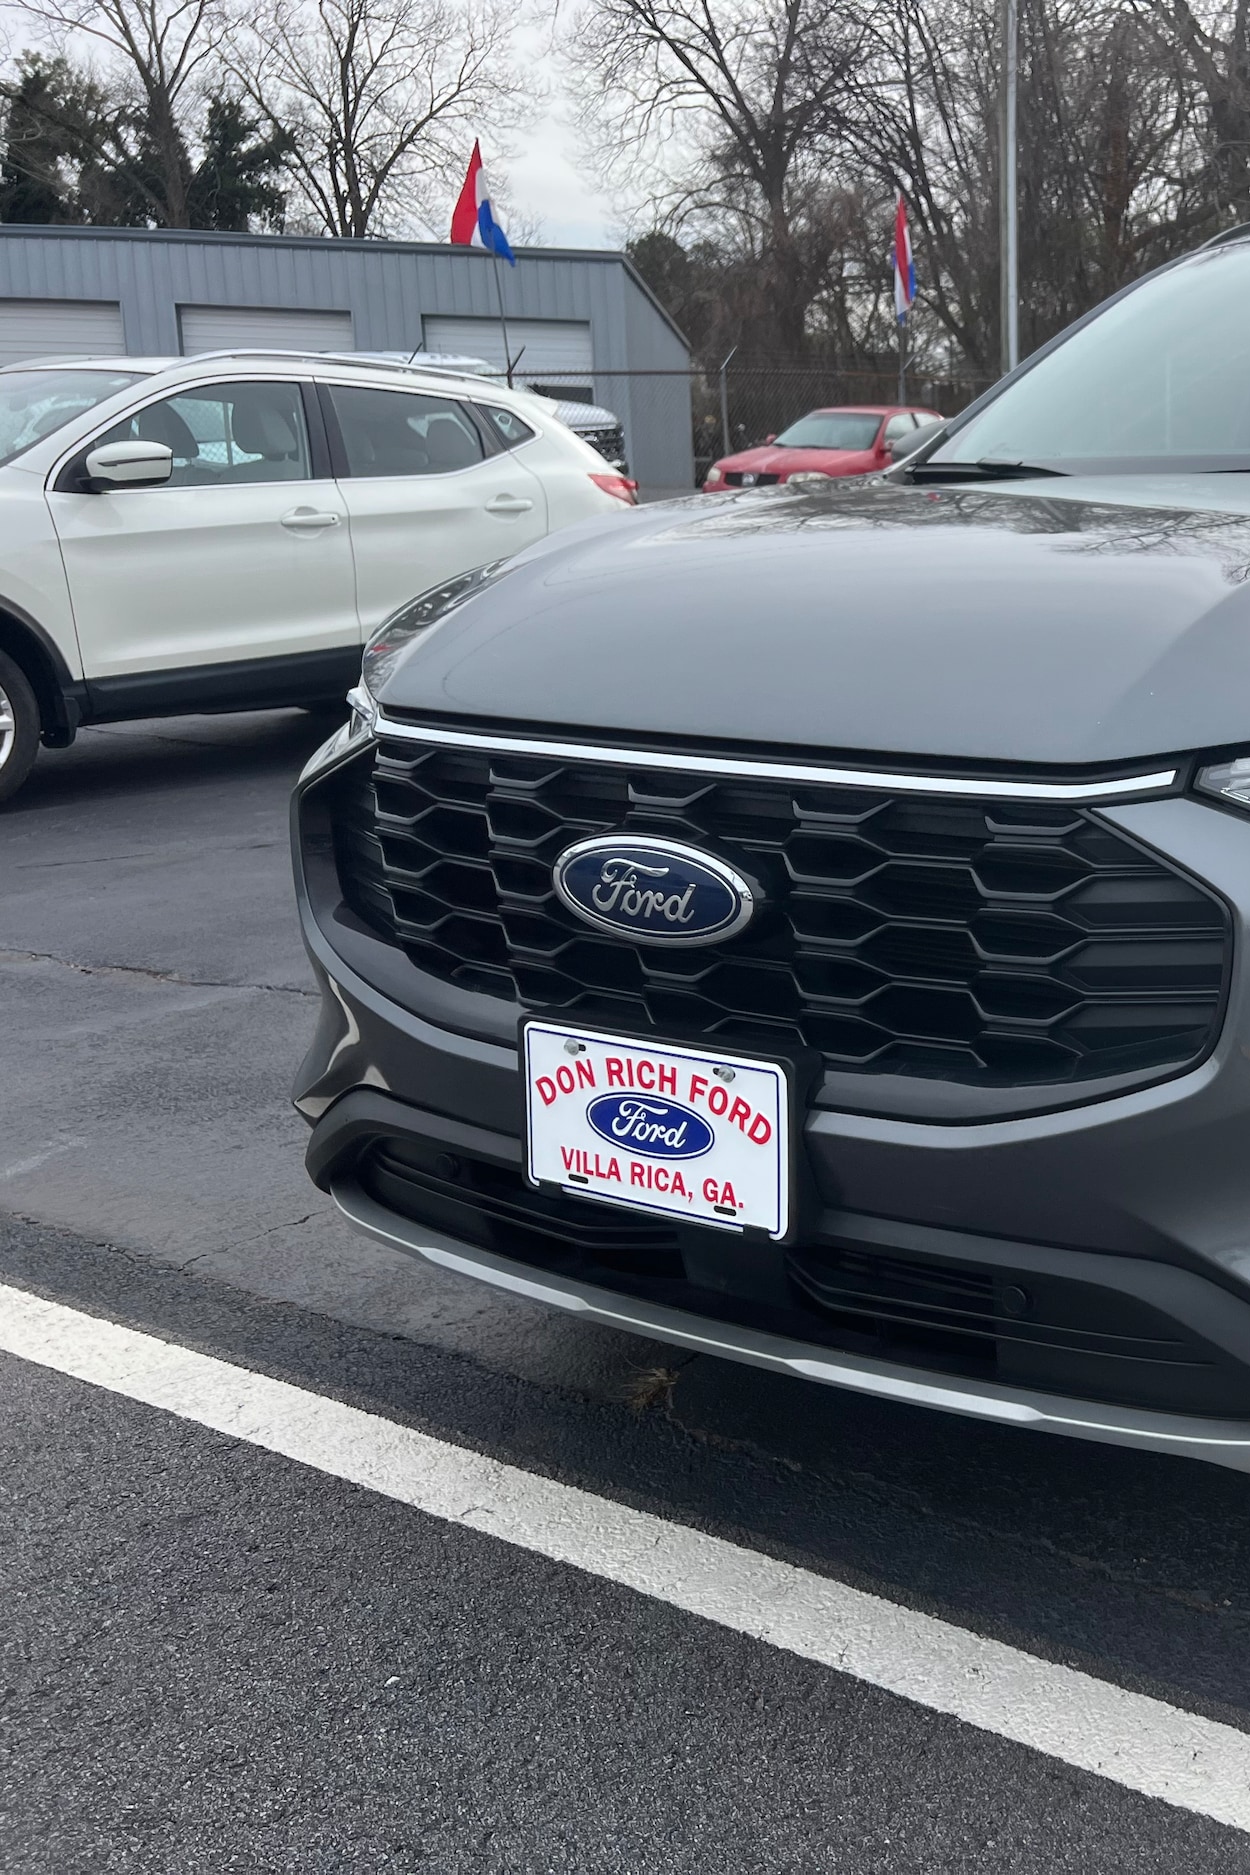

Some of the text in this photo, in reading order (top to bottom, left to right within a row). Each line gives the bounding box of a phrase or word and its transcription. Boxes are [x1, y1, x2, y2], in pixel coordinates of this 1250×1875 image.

[591, 857, 697, 924] Ford
[535, 1057, 772, 1146] DON RICH FORD
[610, 1100, 688, 1149] Ford
[560, 1146, 745, 1209] VILLA RICA, GA.
